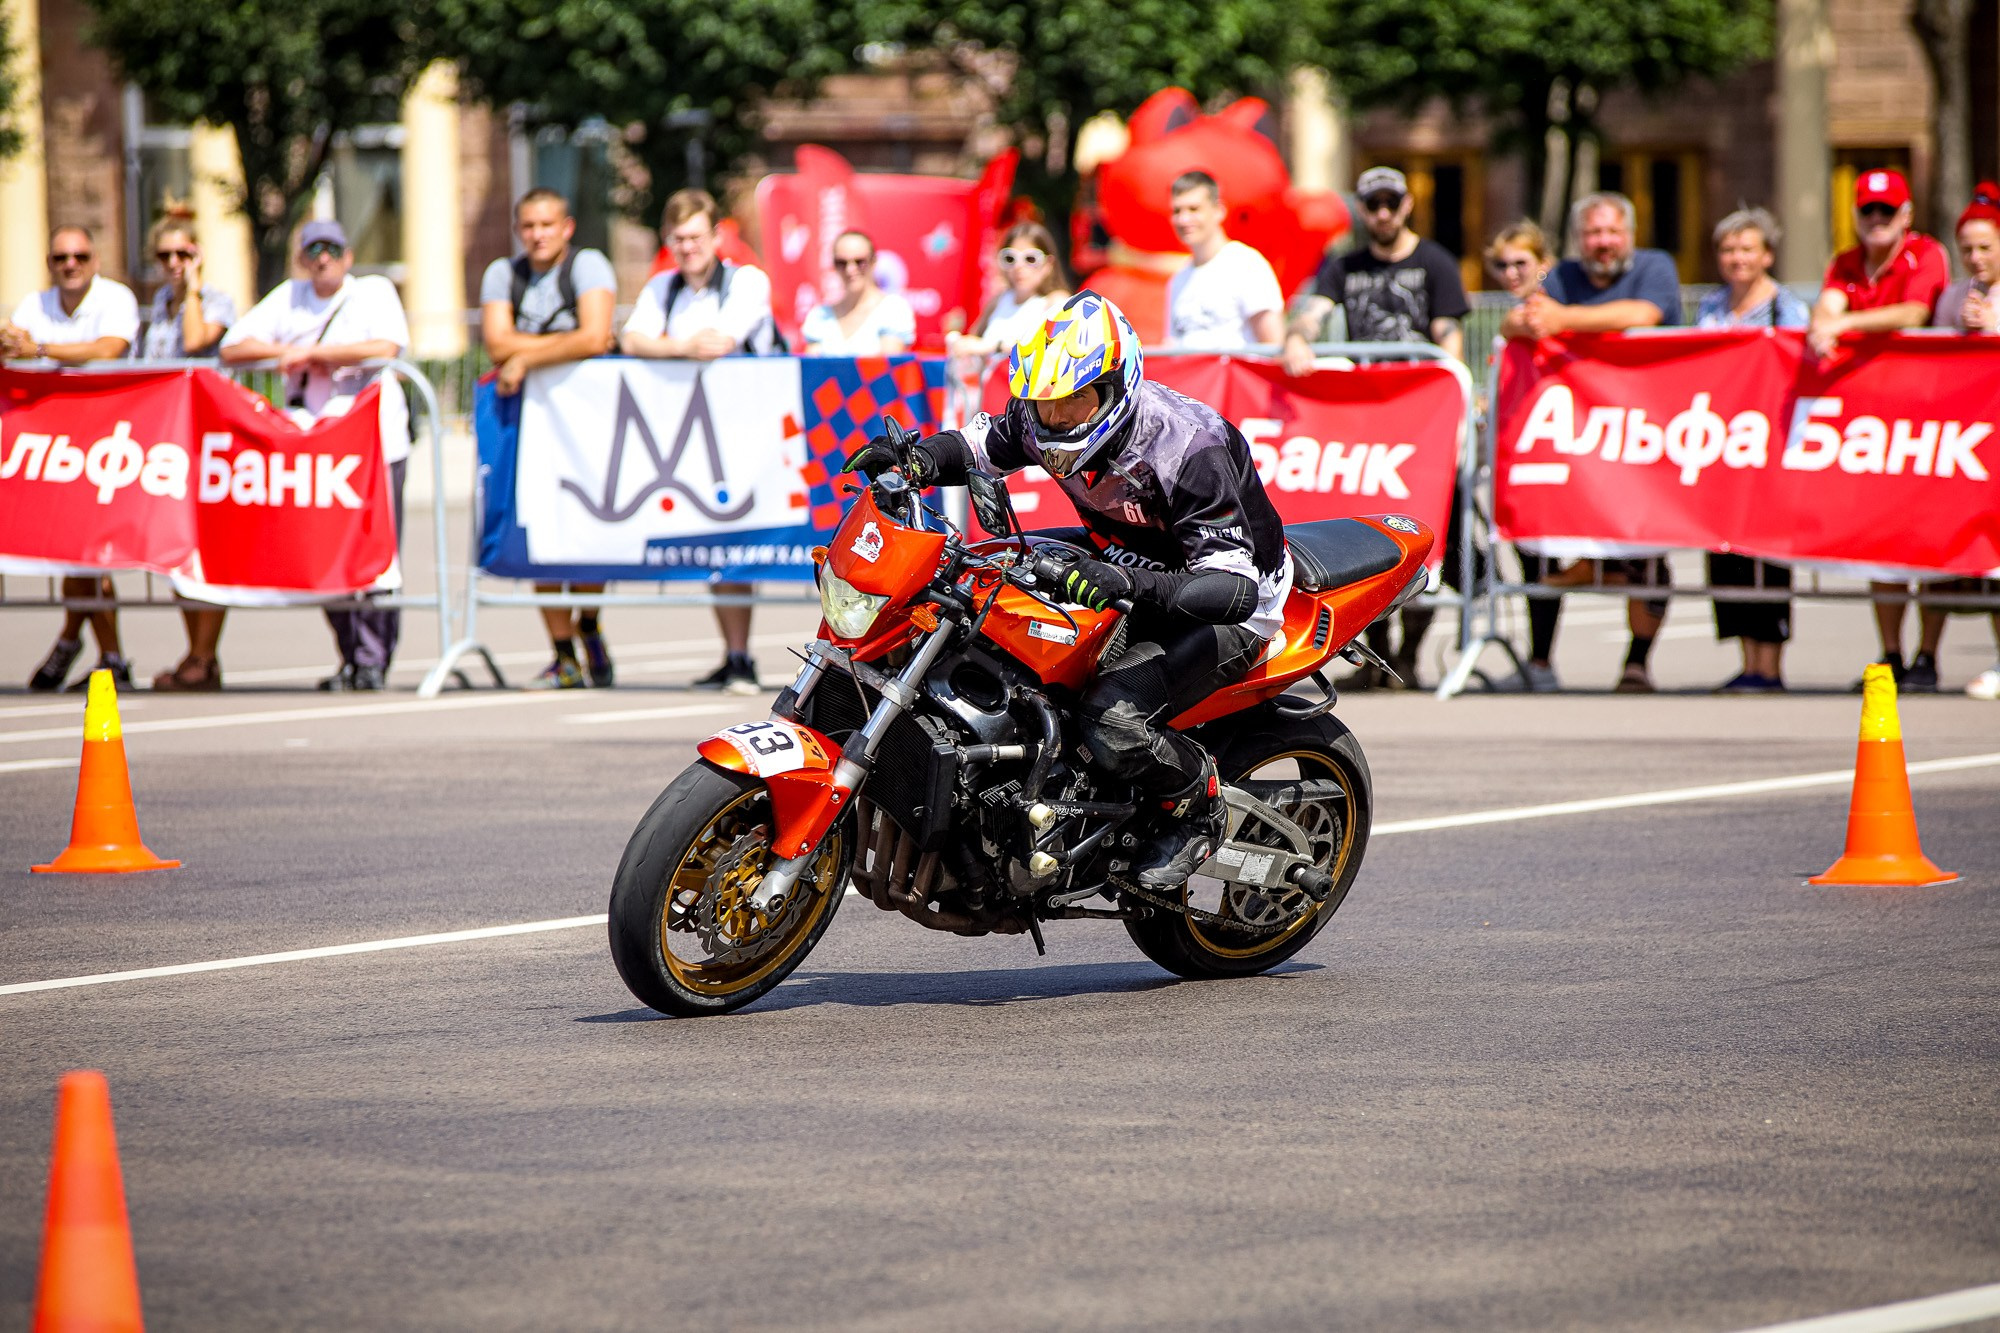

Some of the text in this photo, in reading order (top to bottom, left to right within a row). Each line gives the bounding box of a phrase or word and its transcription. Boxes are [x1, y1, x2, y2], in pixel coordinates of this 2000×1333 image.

[0, 421, 364, 510] льфа Банк
[1240, 417, 1417, 499] Банк
[1511, 384, 1993, 486] Альфа Банк
[1123, 501, 1147, 523] 61
